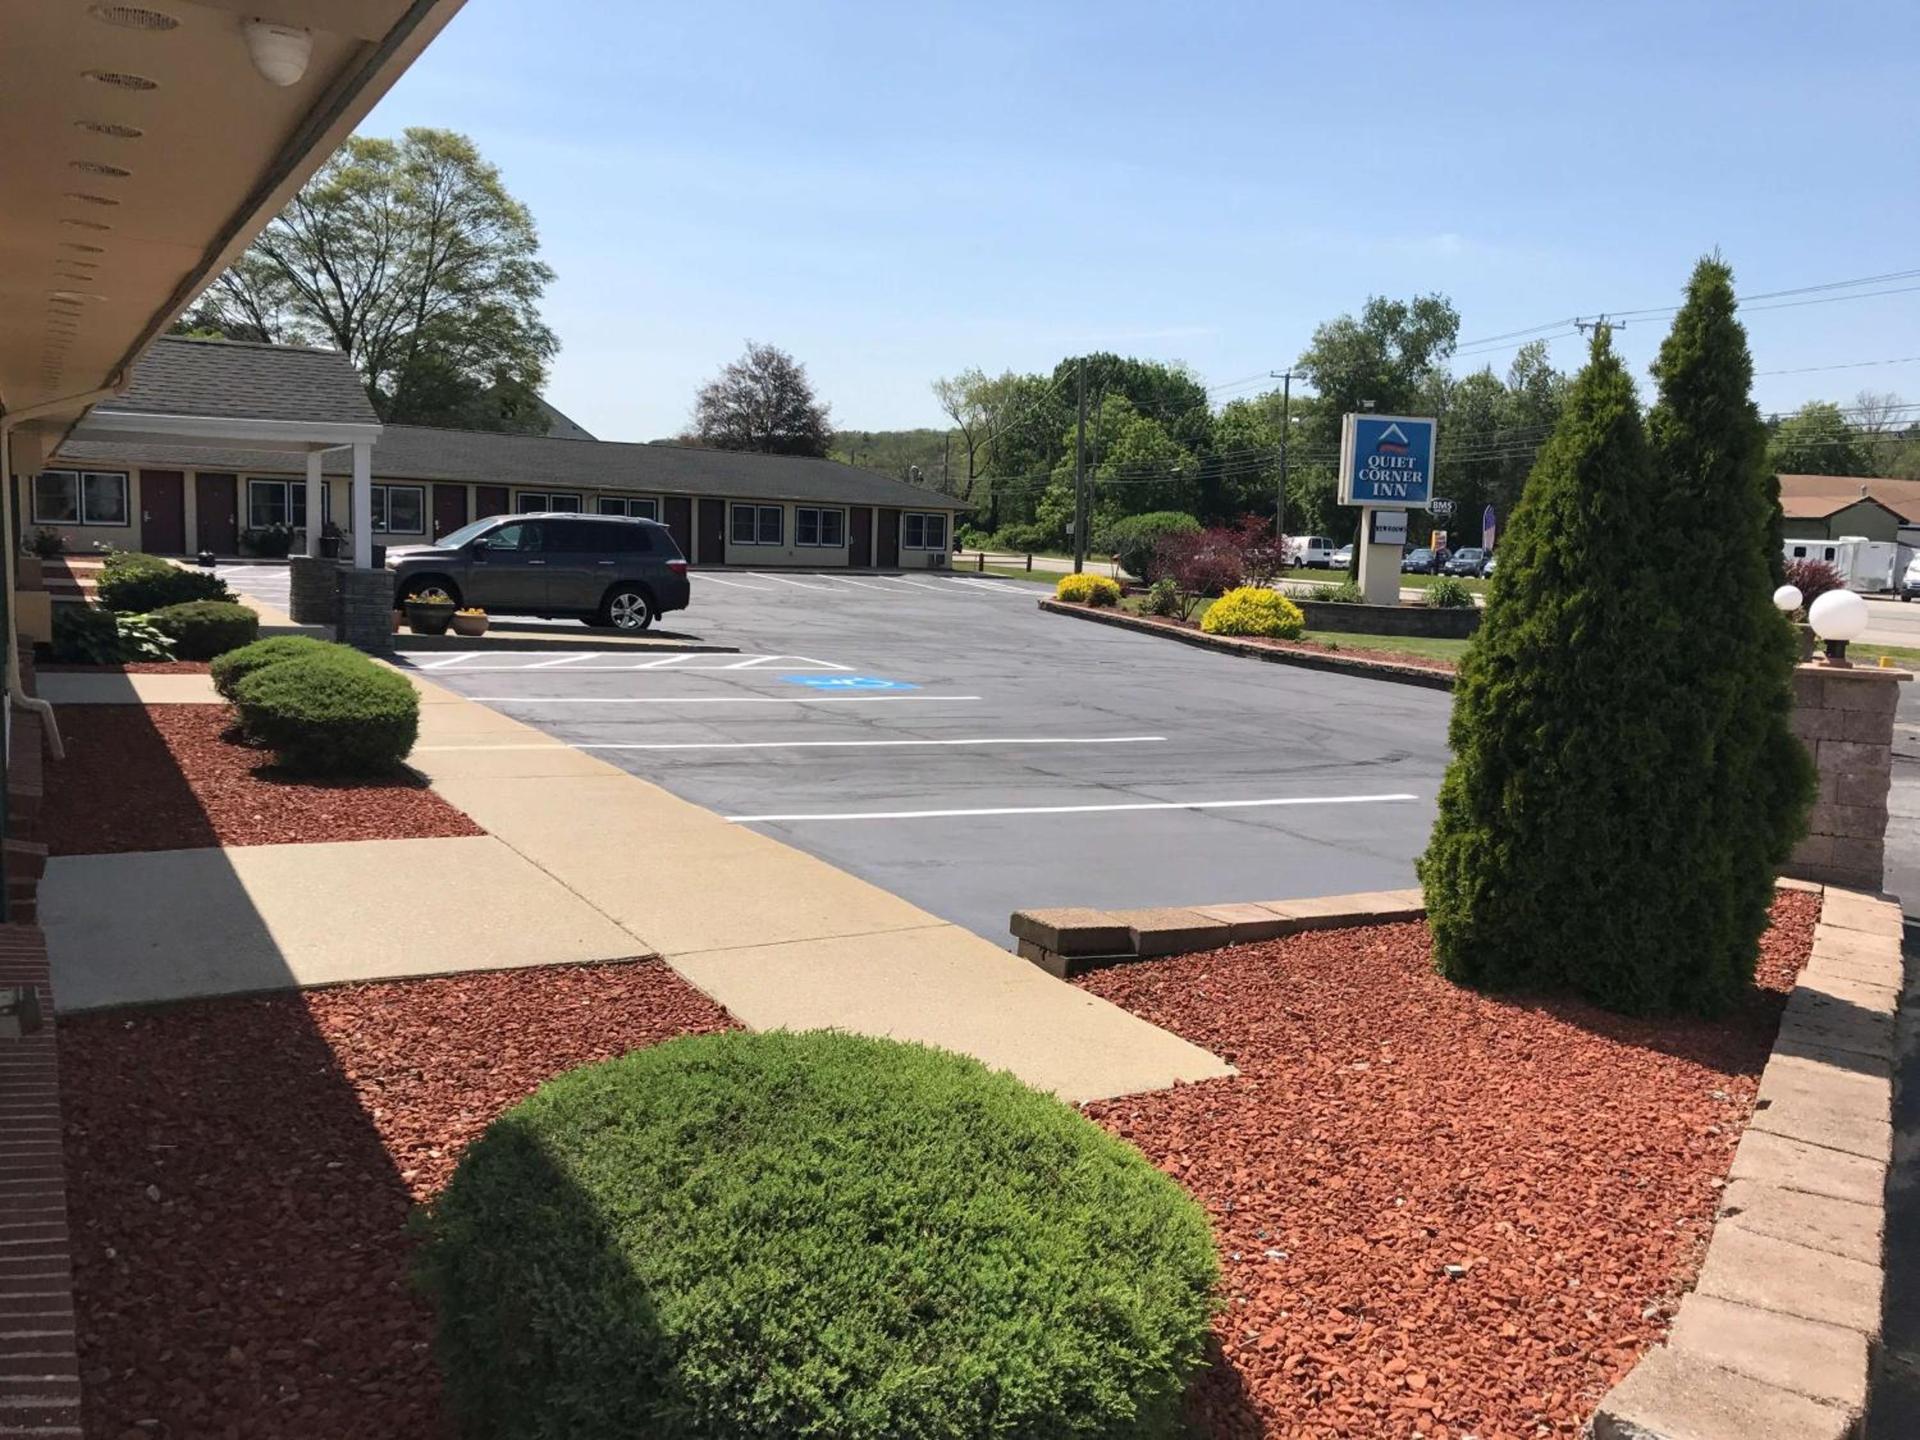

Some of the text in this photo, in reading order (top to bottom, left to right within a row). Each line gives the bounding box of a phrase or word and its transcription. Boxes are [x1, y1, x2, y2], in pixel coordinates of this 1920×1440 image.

[1368, 455, 1416, 470] QUIET
[1359, 469, 1422, 483] CORNER
[1373, 483, 1407, 497] INN
[1433, 501, 1452, 509] BMS
